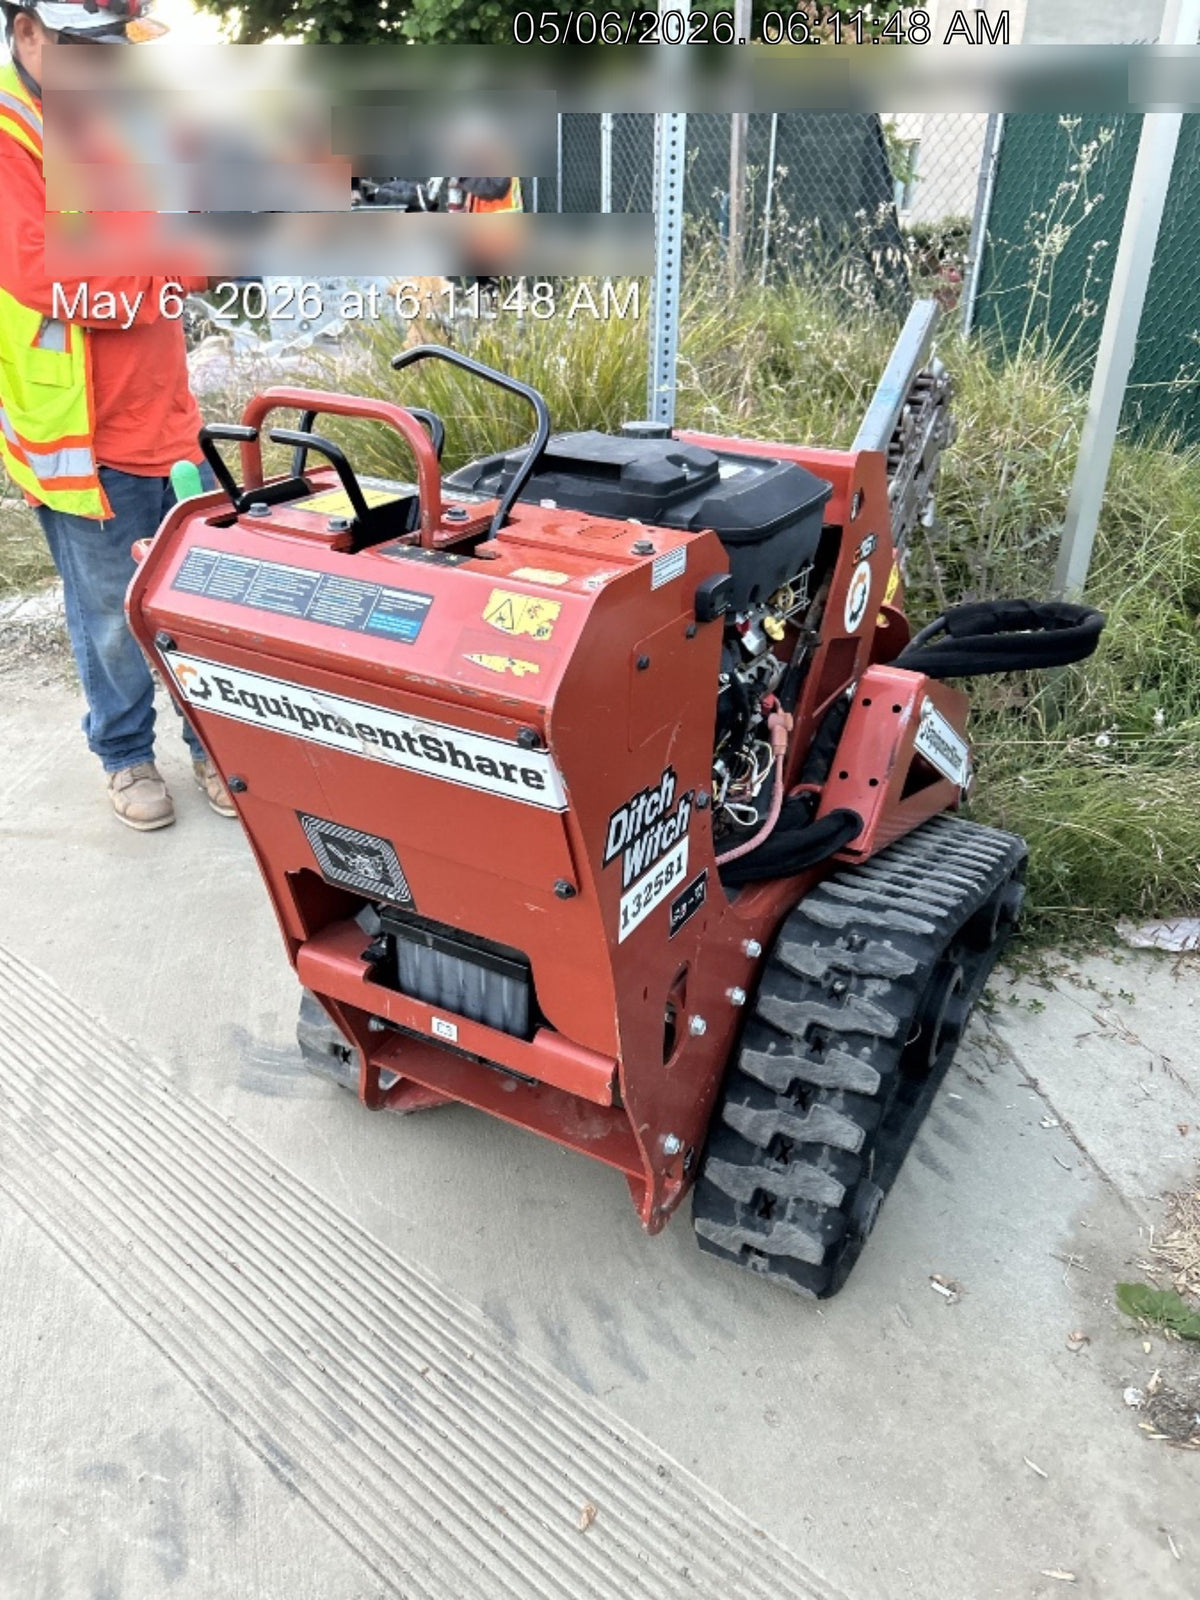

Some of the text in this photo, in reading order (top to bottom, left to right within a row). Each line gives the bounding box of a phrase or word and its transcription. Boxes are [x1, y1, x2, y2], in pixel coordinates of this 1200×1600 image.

[211, 674, 545, 791] EquipmentShare
[603, 767, 677, 866] Ditch
[623, 795, 692, 890] Witch
[621, 851, 684, 930] 132581
